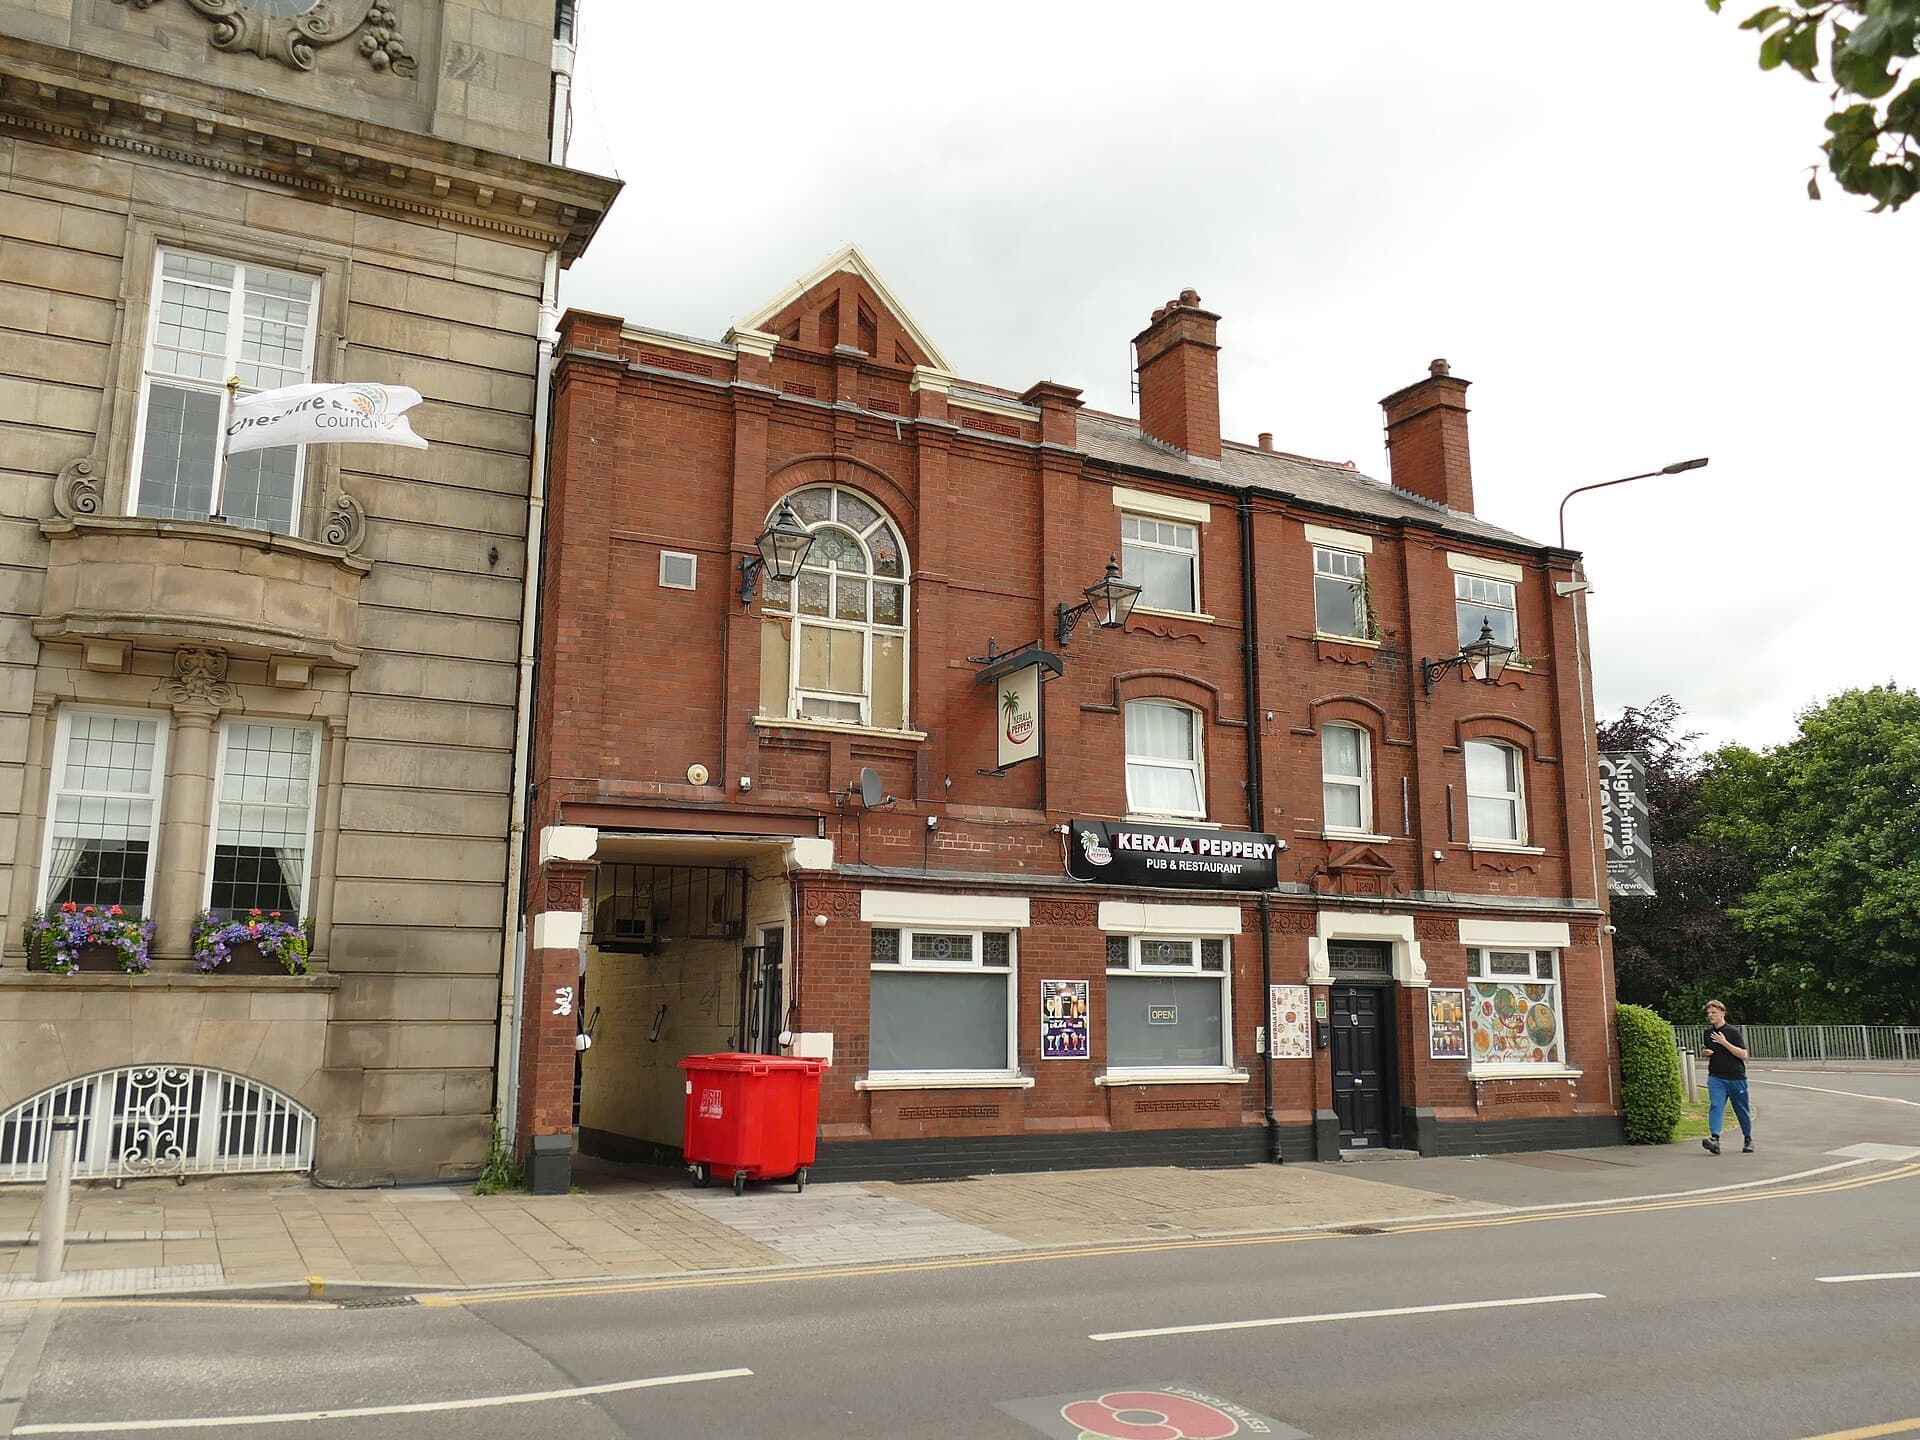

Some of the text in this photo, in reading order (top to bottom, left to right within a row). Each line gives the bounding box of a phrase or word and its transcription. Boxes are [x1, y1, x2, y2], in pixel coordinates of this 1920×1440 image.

[1012, 719, 1033, 735] PEPPERY
[1612, 759, 1638, 857] Night-time
[1117, 832, 1276, 861] KERALA PEPPERY
[1146, 858, 1243, 875] PUB & RESTAURANT
[1151, 1010, 1175, 1020] OPEN
